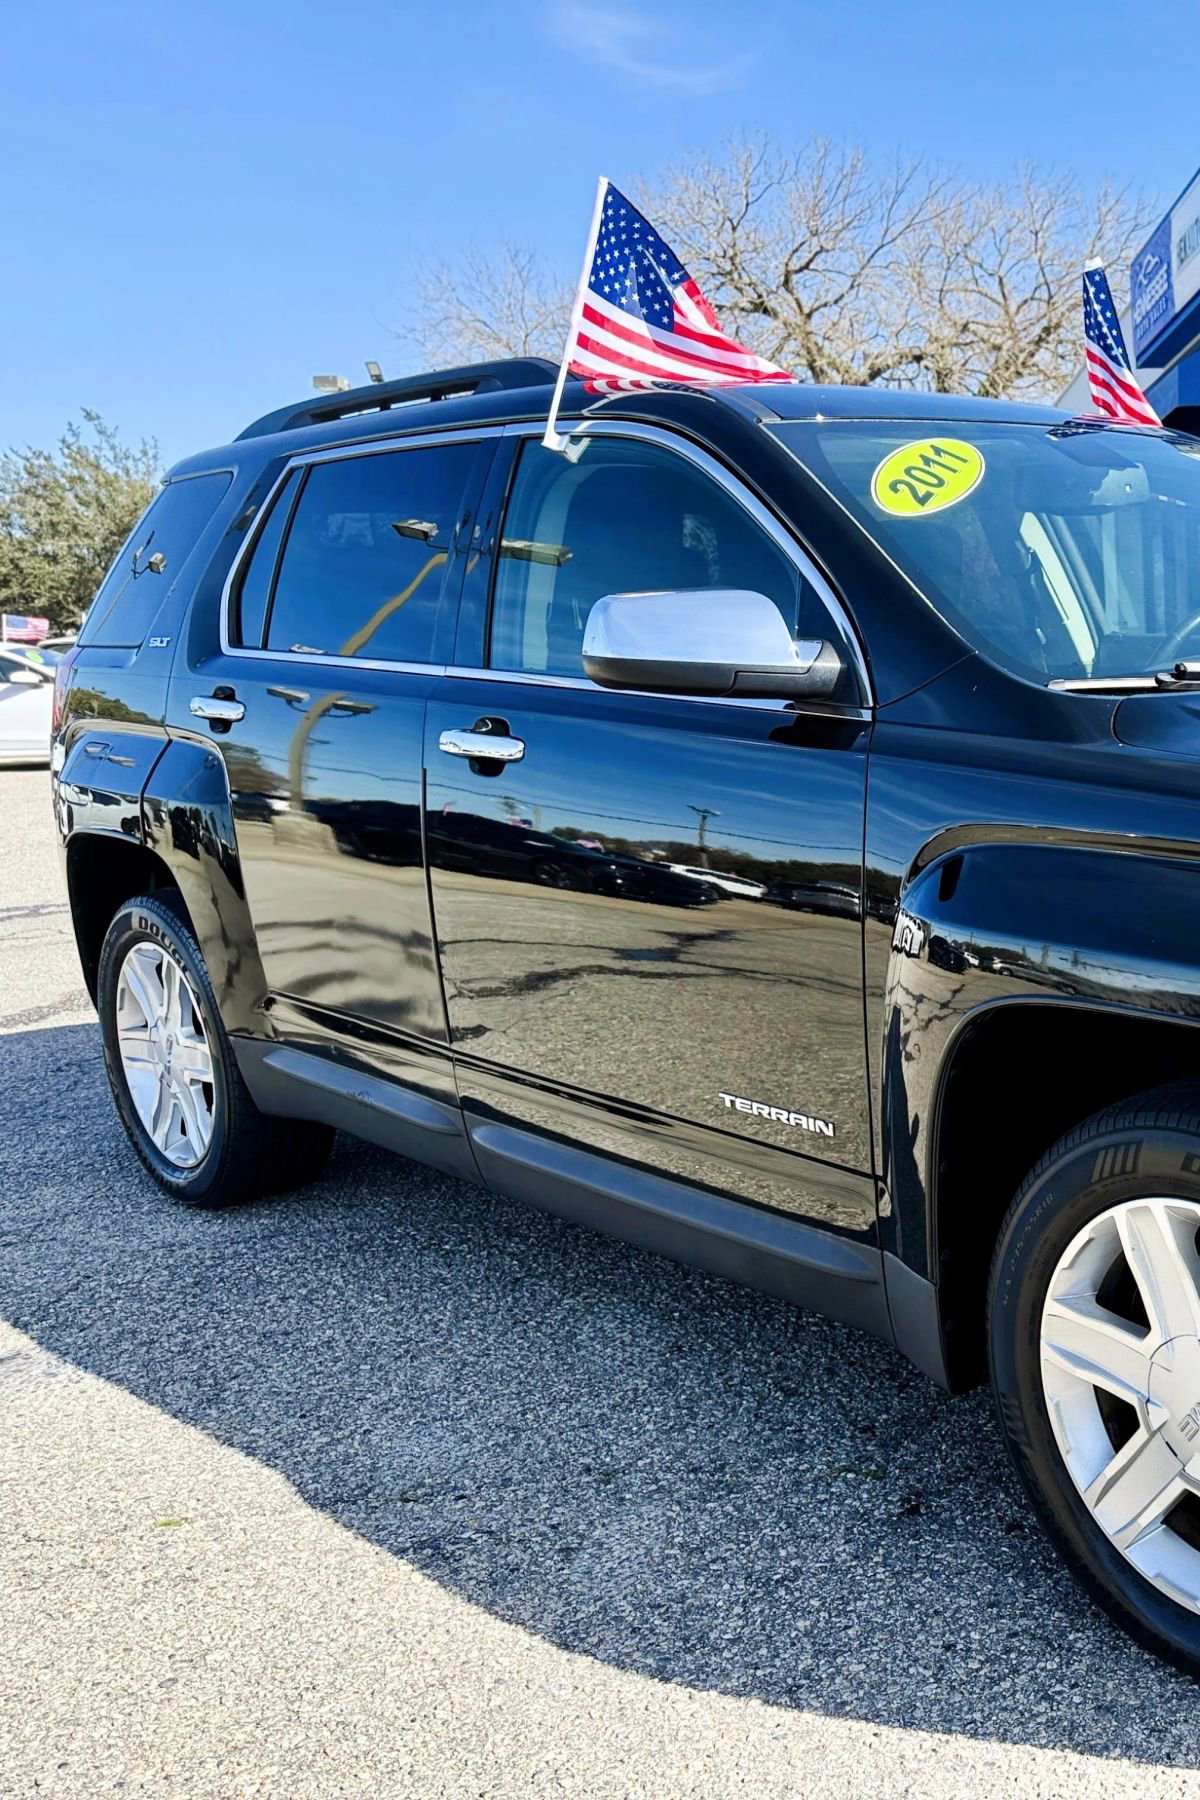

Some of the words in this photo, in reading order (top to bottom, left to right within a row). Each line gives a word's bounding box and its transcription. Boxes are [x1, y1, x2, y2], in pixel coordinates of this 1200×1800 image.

[888, 444, 969, 507] 2011
[148, 636, 171, 648] SLT
[718, 1091, 836, 1138] TERRAIN
